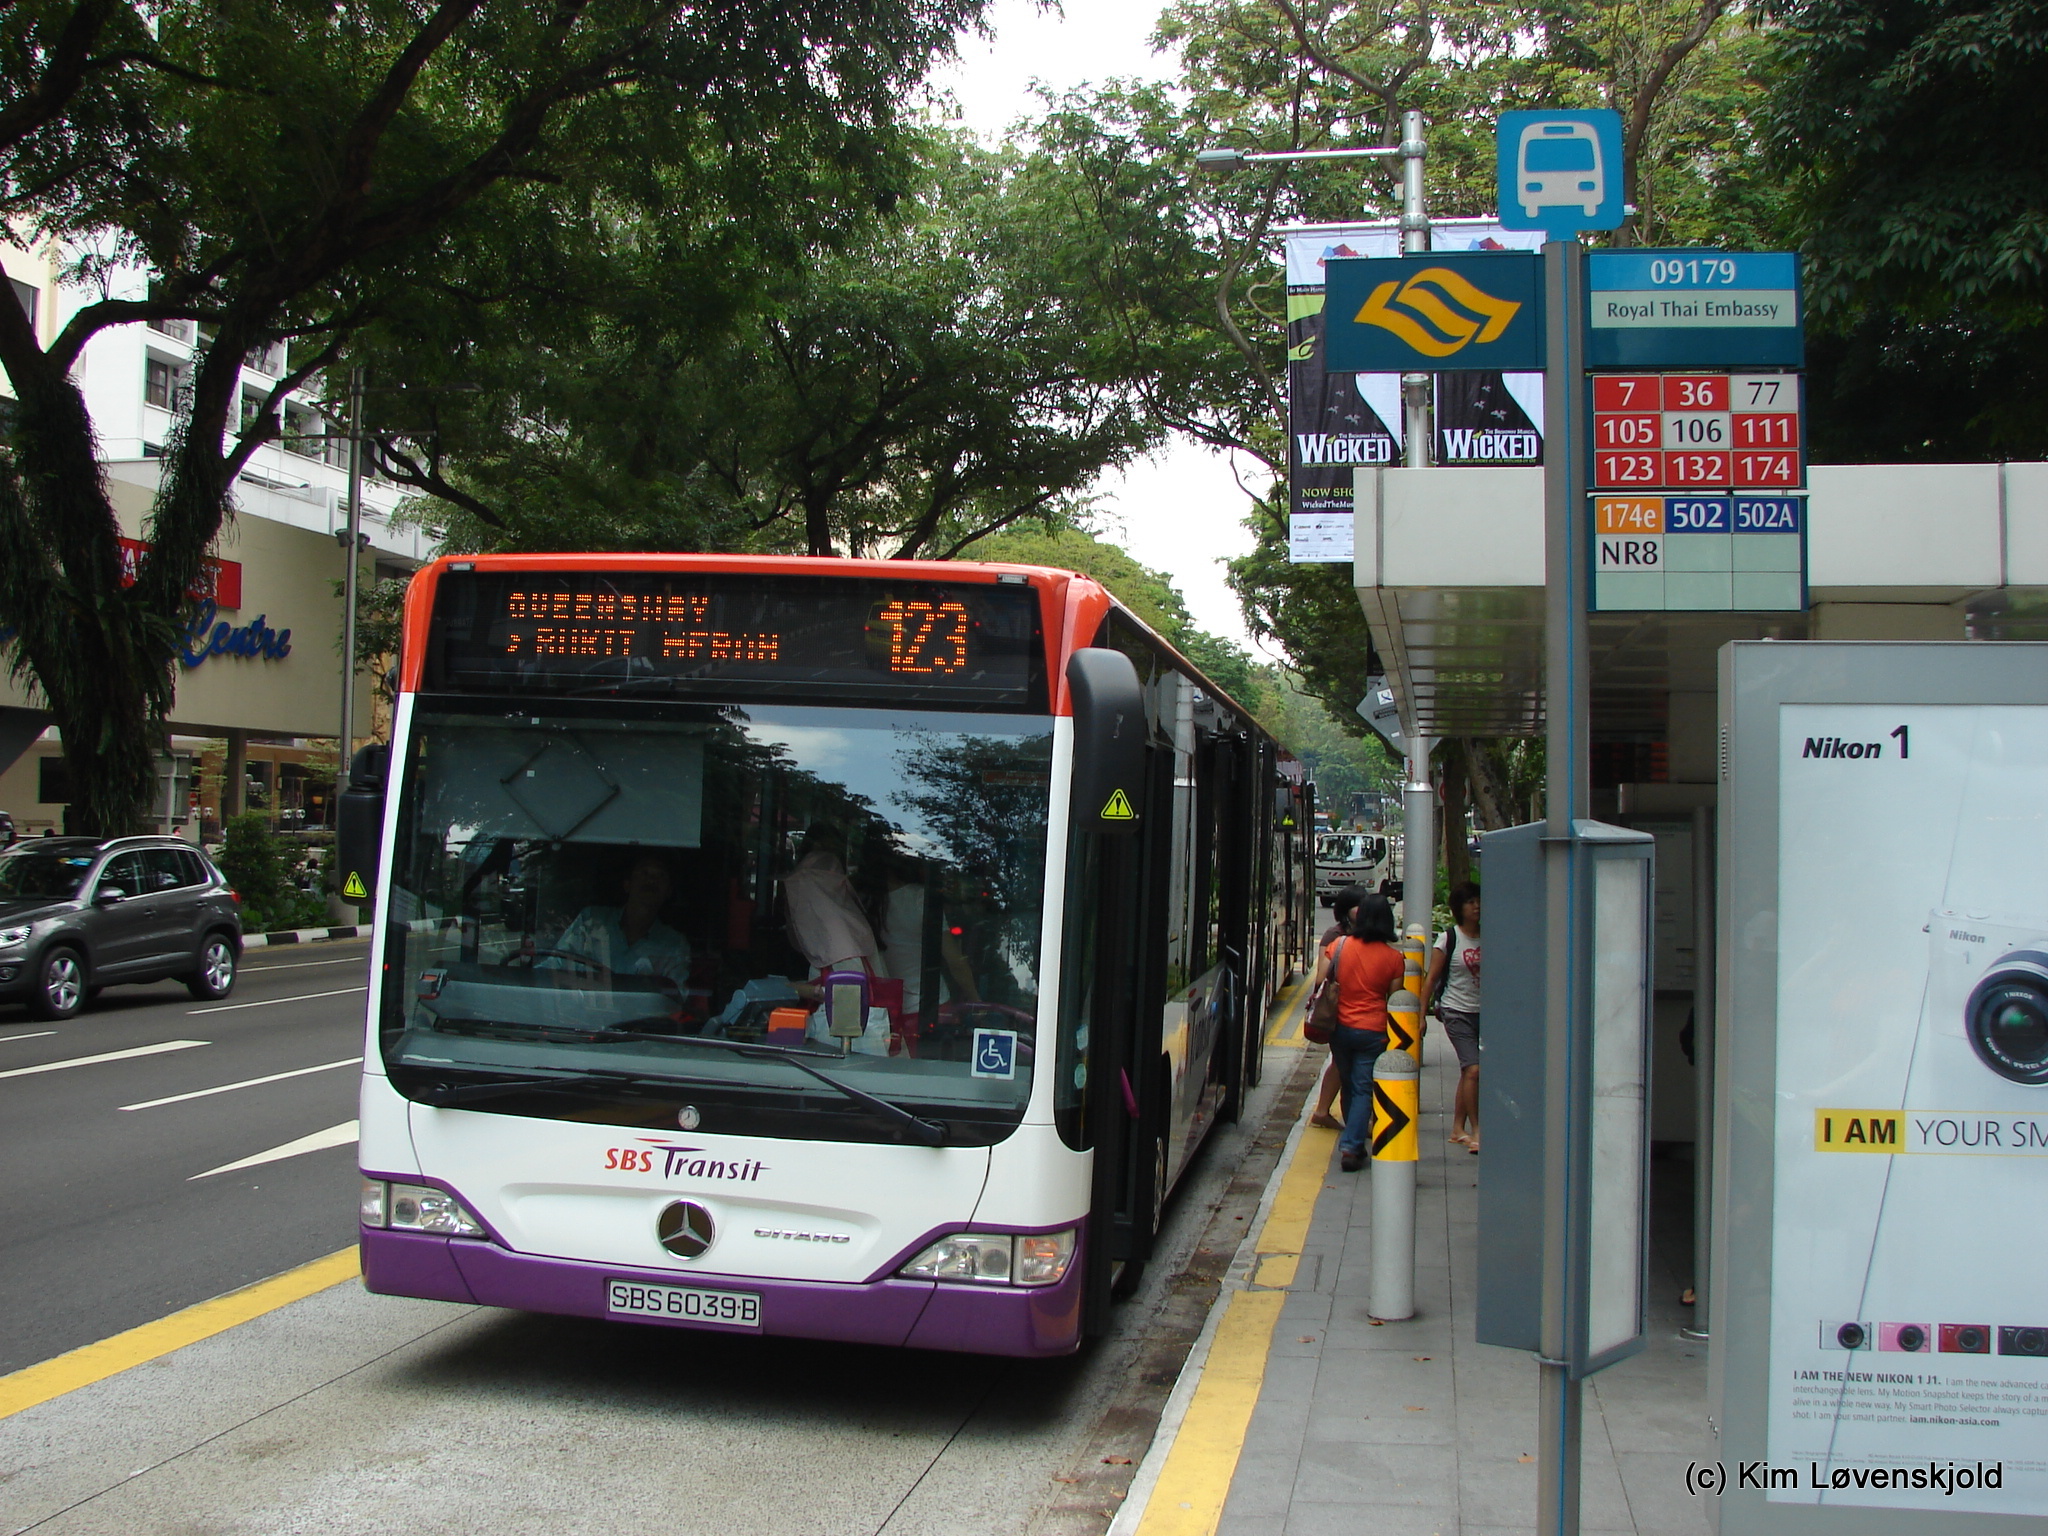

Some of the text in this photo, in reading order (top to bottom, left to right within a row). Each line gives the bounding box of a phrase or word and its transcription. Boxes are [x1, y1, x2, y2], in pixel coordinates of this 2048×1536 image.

[1651, 260, 1735, 284] 09179
[1608, 301, 1778, 321] Royal Thai Embassy
[1619, 381, 1780, 406] 7 36 77
[1602, 419, 1788, 443] 105 106 111
[1604, 457, 1790, 481] 123 132 174
[1302, 488, 1330, 497] NOW
[1602, 503, 1794, 528] 174e 502 502A
[1602, 542, 1658, 565] NR8
[181, 597, 292, 667] Centre
[880, 601, 967, 673] 123
[1802, 725, 1908, 759] Nikon 1
[1949, 930, 1985, 943] Nikon
[1824, 1117, 1831, 1142] I
[1844, 1118, 1896, 1144] AM
[1915, 1119, 2002, 1147] YOUR
[604, 1145, 772, 1182] SBS Transit
[1793, 1371, 1797, 1380] I
[1801, 1371, 1819, 1380] AM
[1823, 1371, 1843, 1381] THE
[1847, 1372, 1873, 1382] NEW
[1877, 1373, 1913, 1384] NIKON
[1917, 1375, 1922, 1384] 1
[1966, 1379, 1978, 1387] the
[2000, 1381, 2038, 1389] advanced
[1792, 1398, 1811, 1406] alive
[1909, 1401, 1931, 1411] Smart
[1934, 1403, 1957, 1411] Photo
[1960, 1404, 1990, 1413] Selector
[1993, 1405, 2020, 1416] always
[1893, 1388, 1920, 1398] Motion
[1923, 1390, 1959, 1399] Snapshot
[1962, 1391, 1983, 1401] keeps
[1987, 1391, 1999, 1400] the
[2002, 1393, 2020, 1403] story
[2023, 1393, 2031, 1401] of
